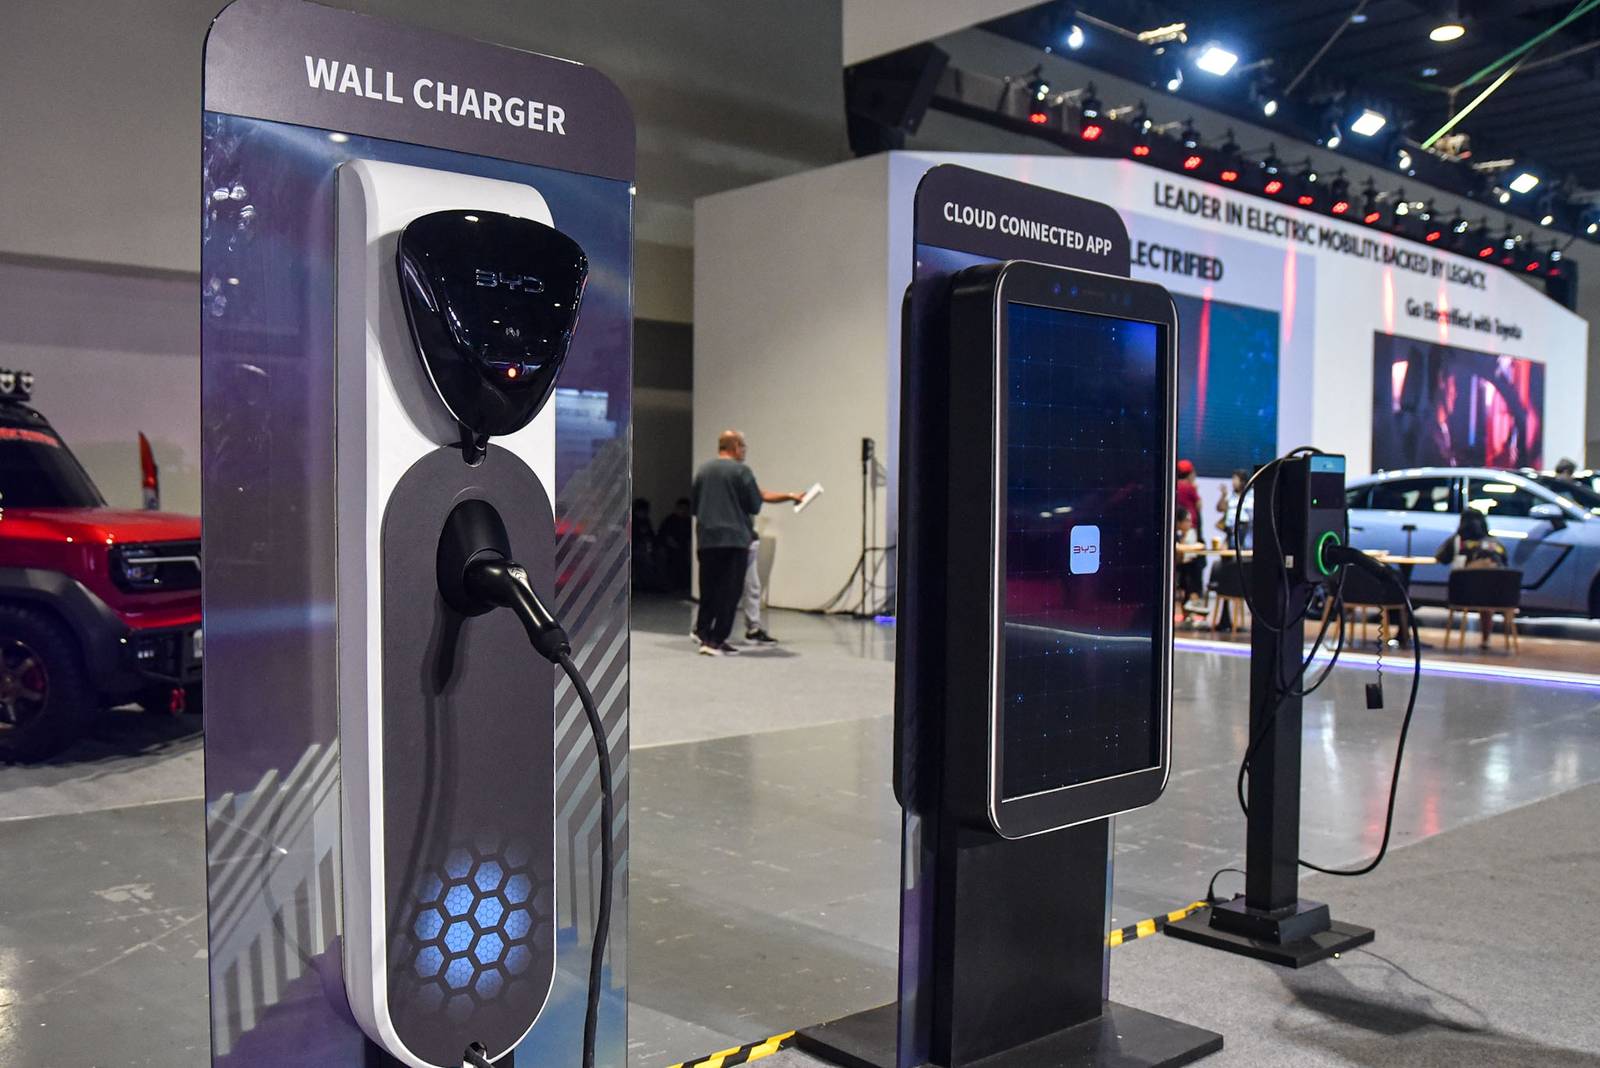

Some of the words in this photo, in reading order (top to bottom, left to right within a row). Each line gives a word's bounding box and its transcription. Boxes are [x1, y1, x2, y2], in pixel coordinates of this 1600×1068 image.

[305, 55, 403, 104] WALL
[413, 78, 566, 135] CHARGER
[943, 201, 996, 230] CLOUD
[1000, 214, 1083, 251] CONNECTED
[1086, 233, 1112, 256] APP
[1154, 181, 1221, 222] LEADER
[1225, 201, 1242, 227] IN
[1247, 207, 1315, 245] ELECTRIC
[1383, 243, 1429, 275] BACKED
[1431, 257, 1443, 277] BY
[475, 268, 544, 293] BYD
[1131, 239, 1223, 282] LECTRIFIED
[1406, 298, 1420, 317] Go
[1423, 301, 1472, 329] Elerified
[1474, 315, 1491, 333] with
[1494, 317, 1522, 340] Toyota
[1072, 545, 1097, 554] BYD
